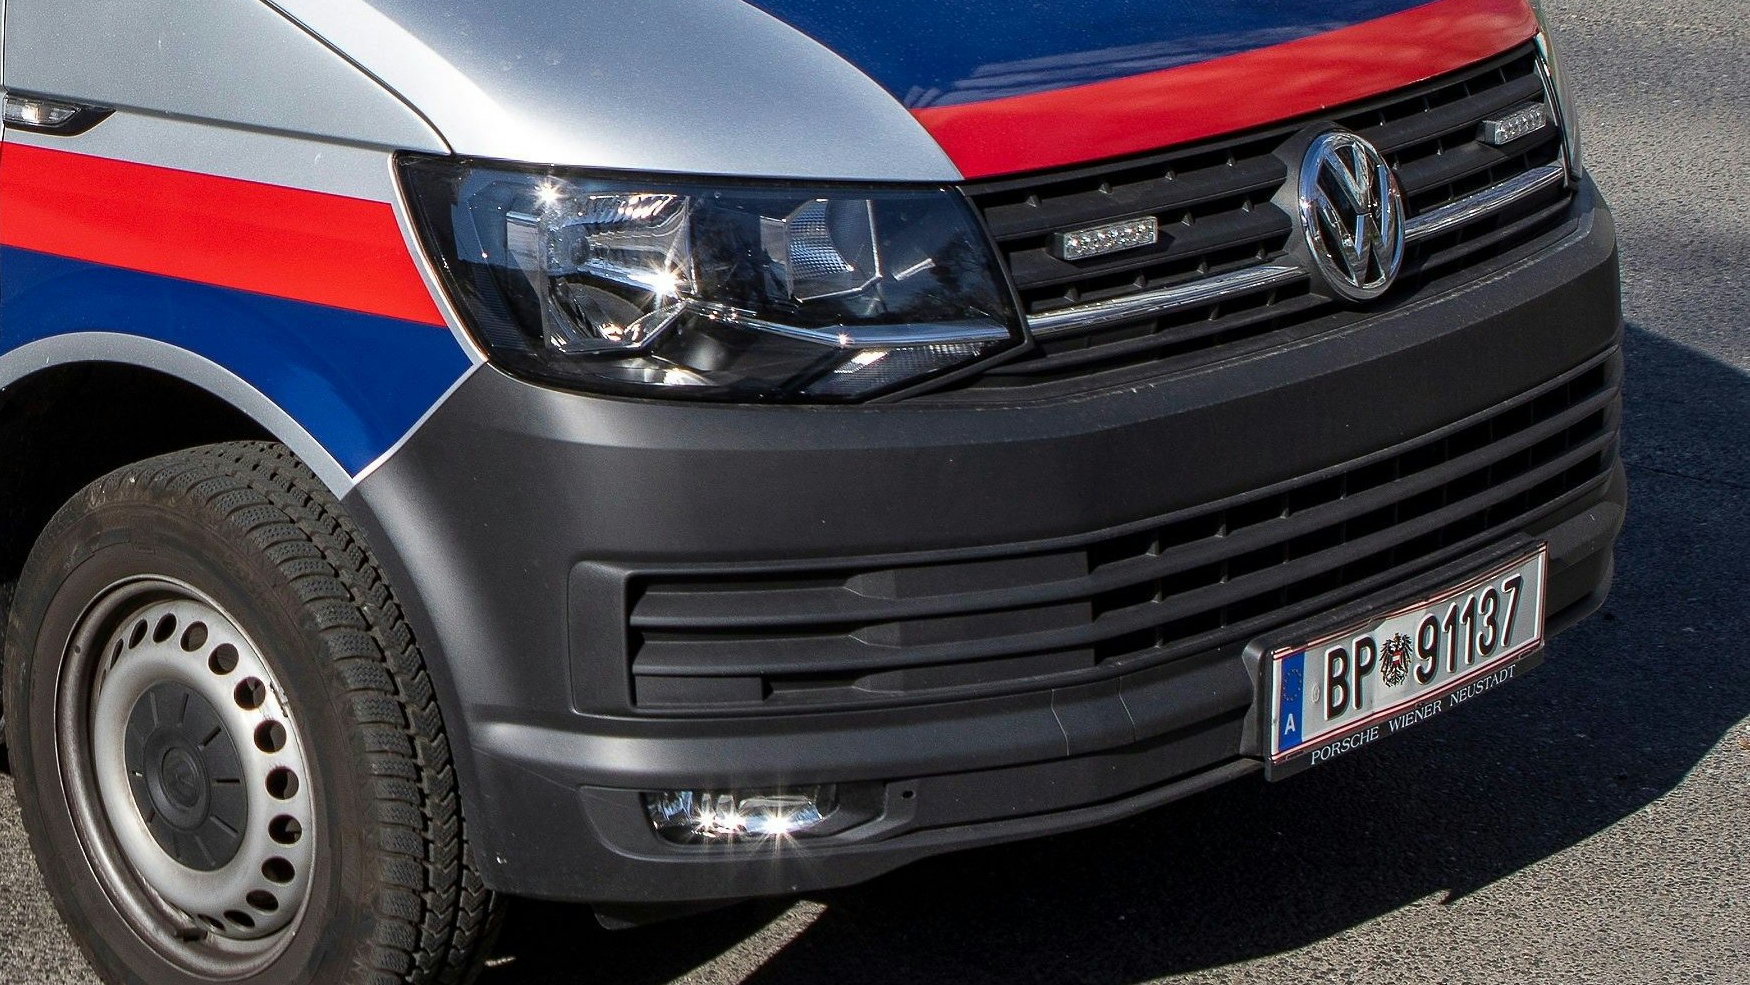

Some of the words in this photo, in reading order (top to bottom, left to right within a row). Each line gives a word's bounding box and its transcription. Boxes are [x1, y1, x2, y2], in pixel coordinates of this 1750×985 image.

[1324, 634, 1378, 721] BP
[1413, 573, 1524, 685] 91137
[1284, 712, 1296, 736] A
[1311, 725, 1380, 766] PORSCHE
[1388, 699, 1443, 733] WIENER
[1449, 663, 1517, 705] NEUSTADT
